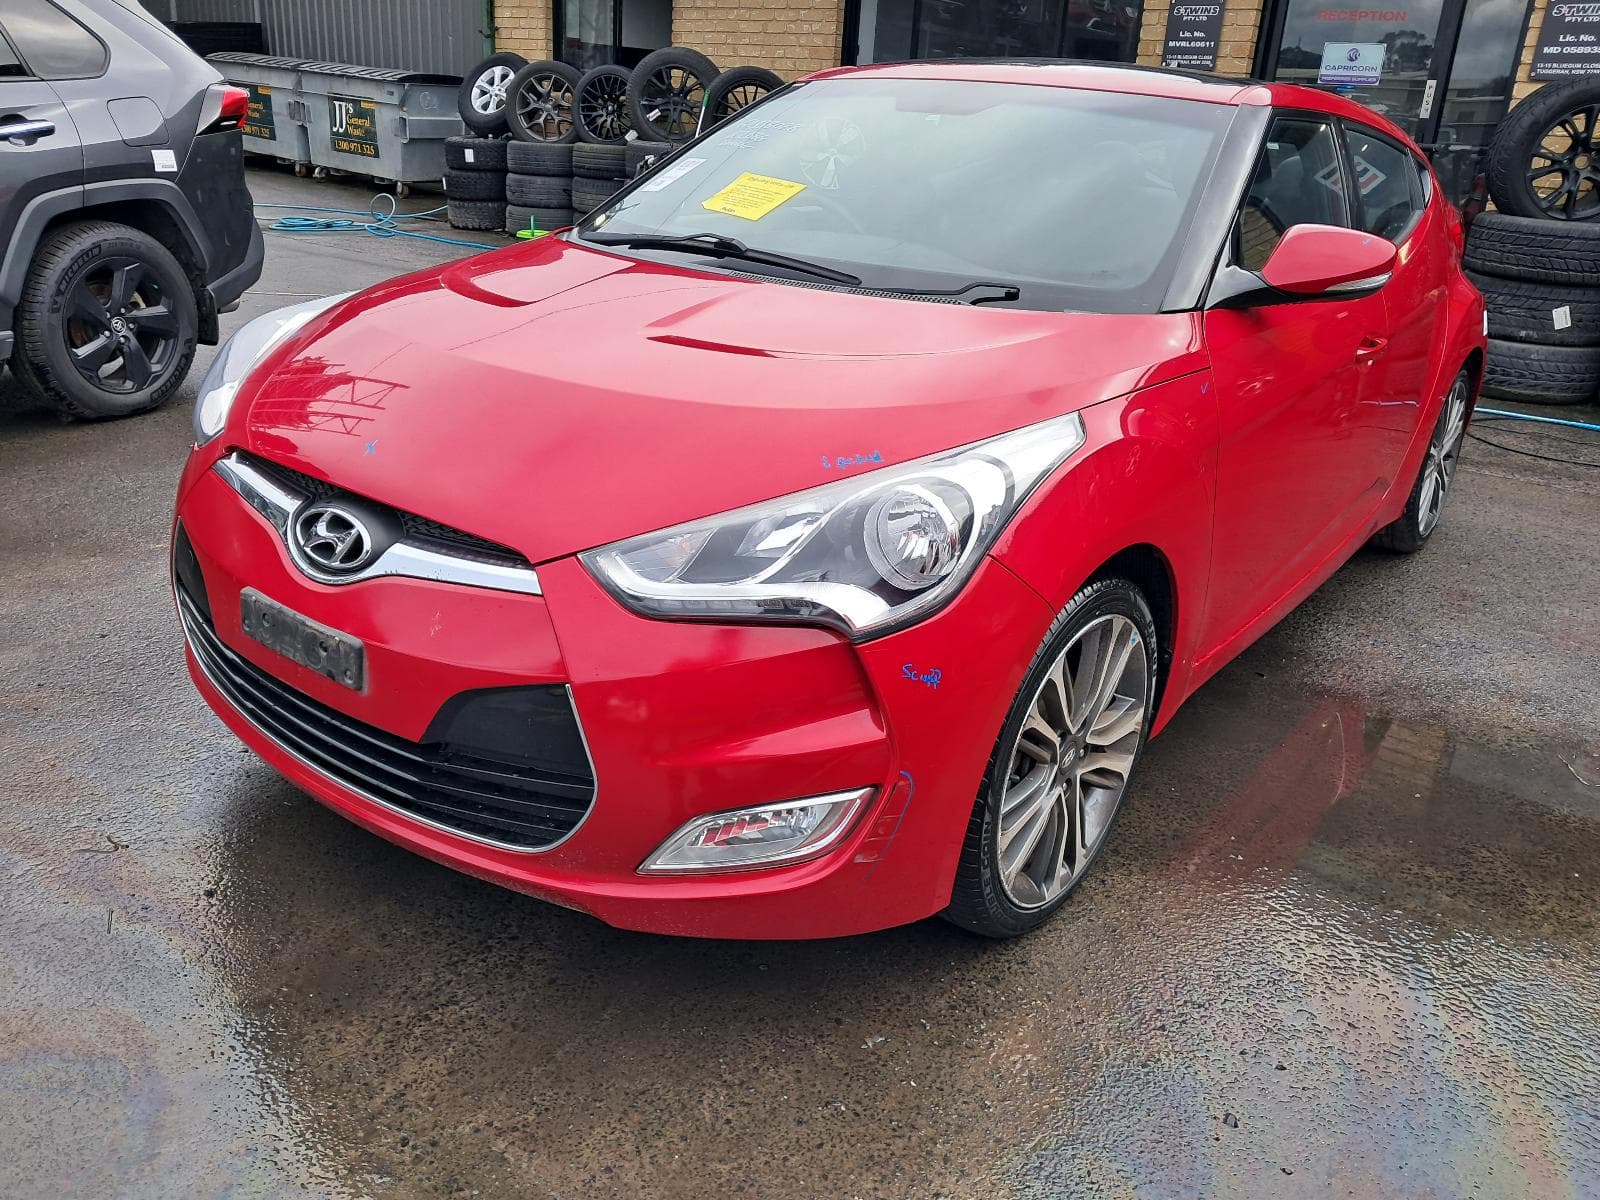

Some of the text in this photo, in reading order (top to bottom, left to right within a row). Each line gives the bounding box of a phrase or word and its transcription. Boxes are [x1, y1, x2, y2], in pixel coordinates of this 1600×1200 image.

[1316, 9, 1408, 22] RECEPTION
[1559, 34, 1597, 42] Lic. No.
[1543, 46, 1562, 54] MD
[1324, 65, 1378, 73] CAPRICORN
[346, 114, 371, 127] General
[346, 124, 366, 136] Waste
[335, 140, 375, 155] 1300 971 325
[59, 245, 102, 293] MICHELIN
[151, 356, 189, 401] MICHELIN
